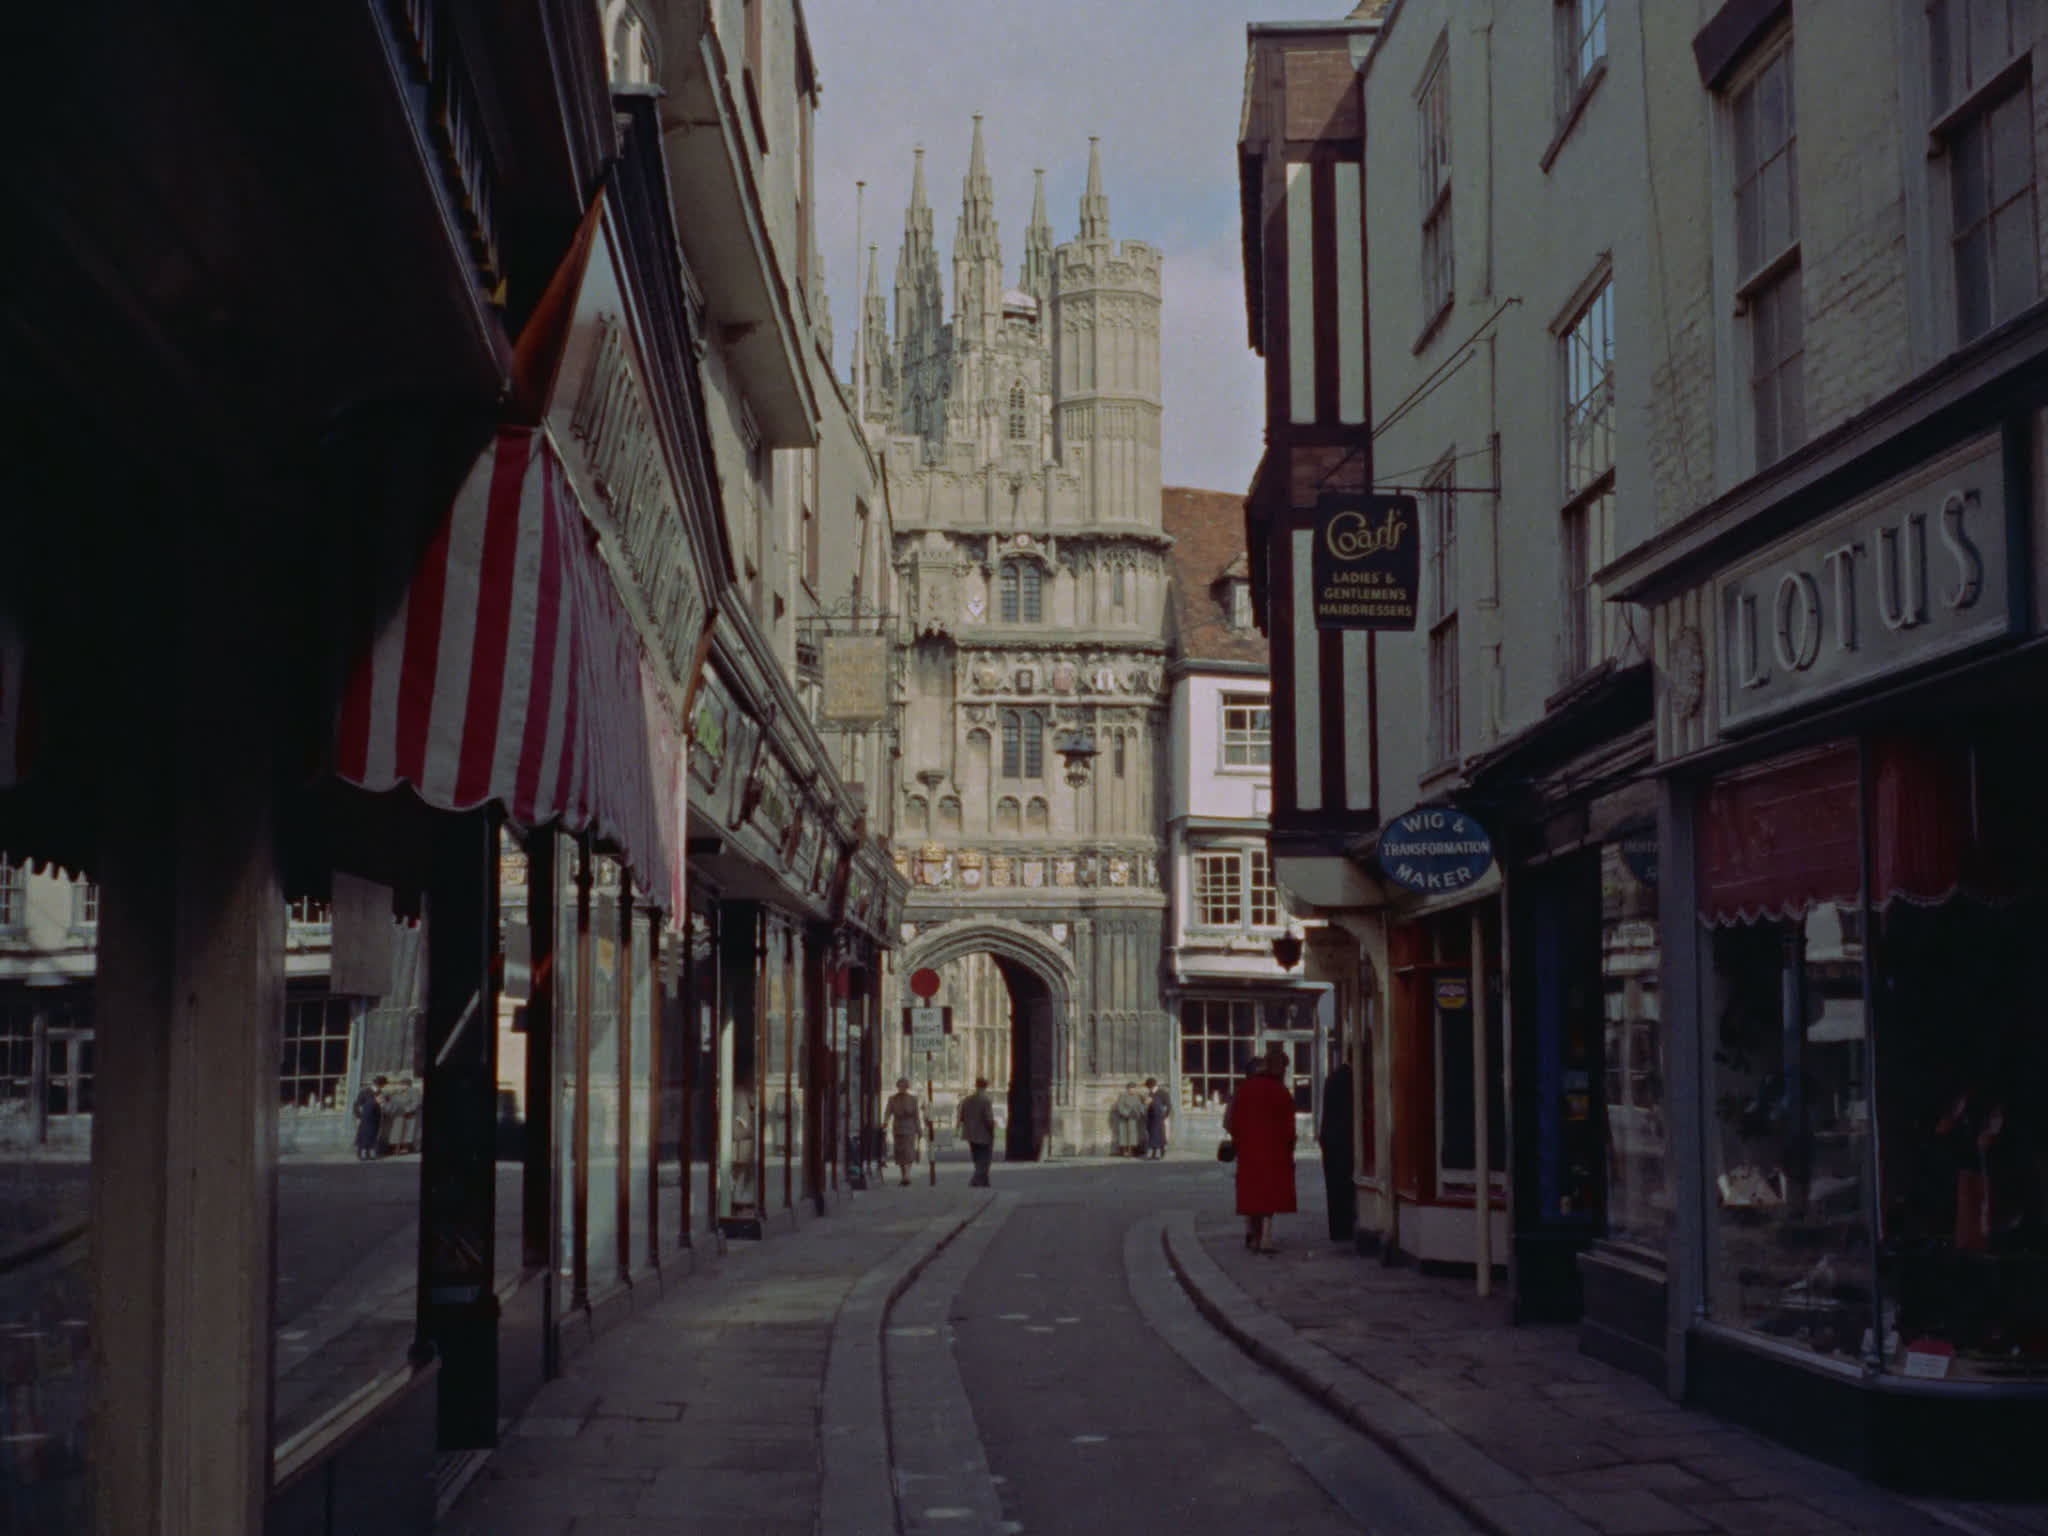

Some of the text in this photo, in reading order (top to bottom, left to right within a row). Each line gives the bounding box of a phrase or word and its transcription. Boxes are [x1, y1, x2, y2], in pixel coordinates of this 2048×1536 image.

[1384, 572, 1397, 584] &
[1737, 487, 1983, 689] LOTUS
[1319, 604, 1413, 616] HAIRDRESSERS
[1402, 813, 1465, 833] WIG &
[1383, 840, 1491, 856] TRANSFORMATION
[1394, 863, 1472, 888] MAKER
[921, 1012, 934, 1020] NO
[914, 1024, 941, 1032] RIGHT
[914, 1039, 942, 1047] TURN
